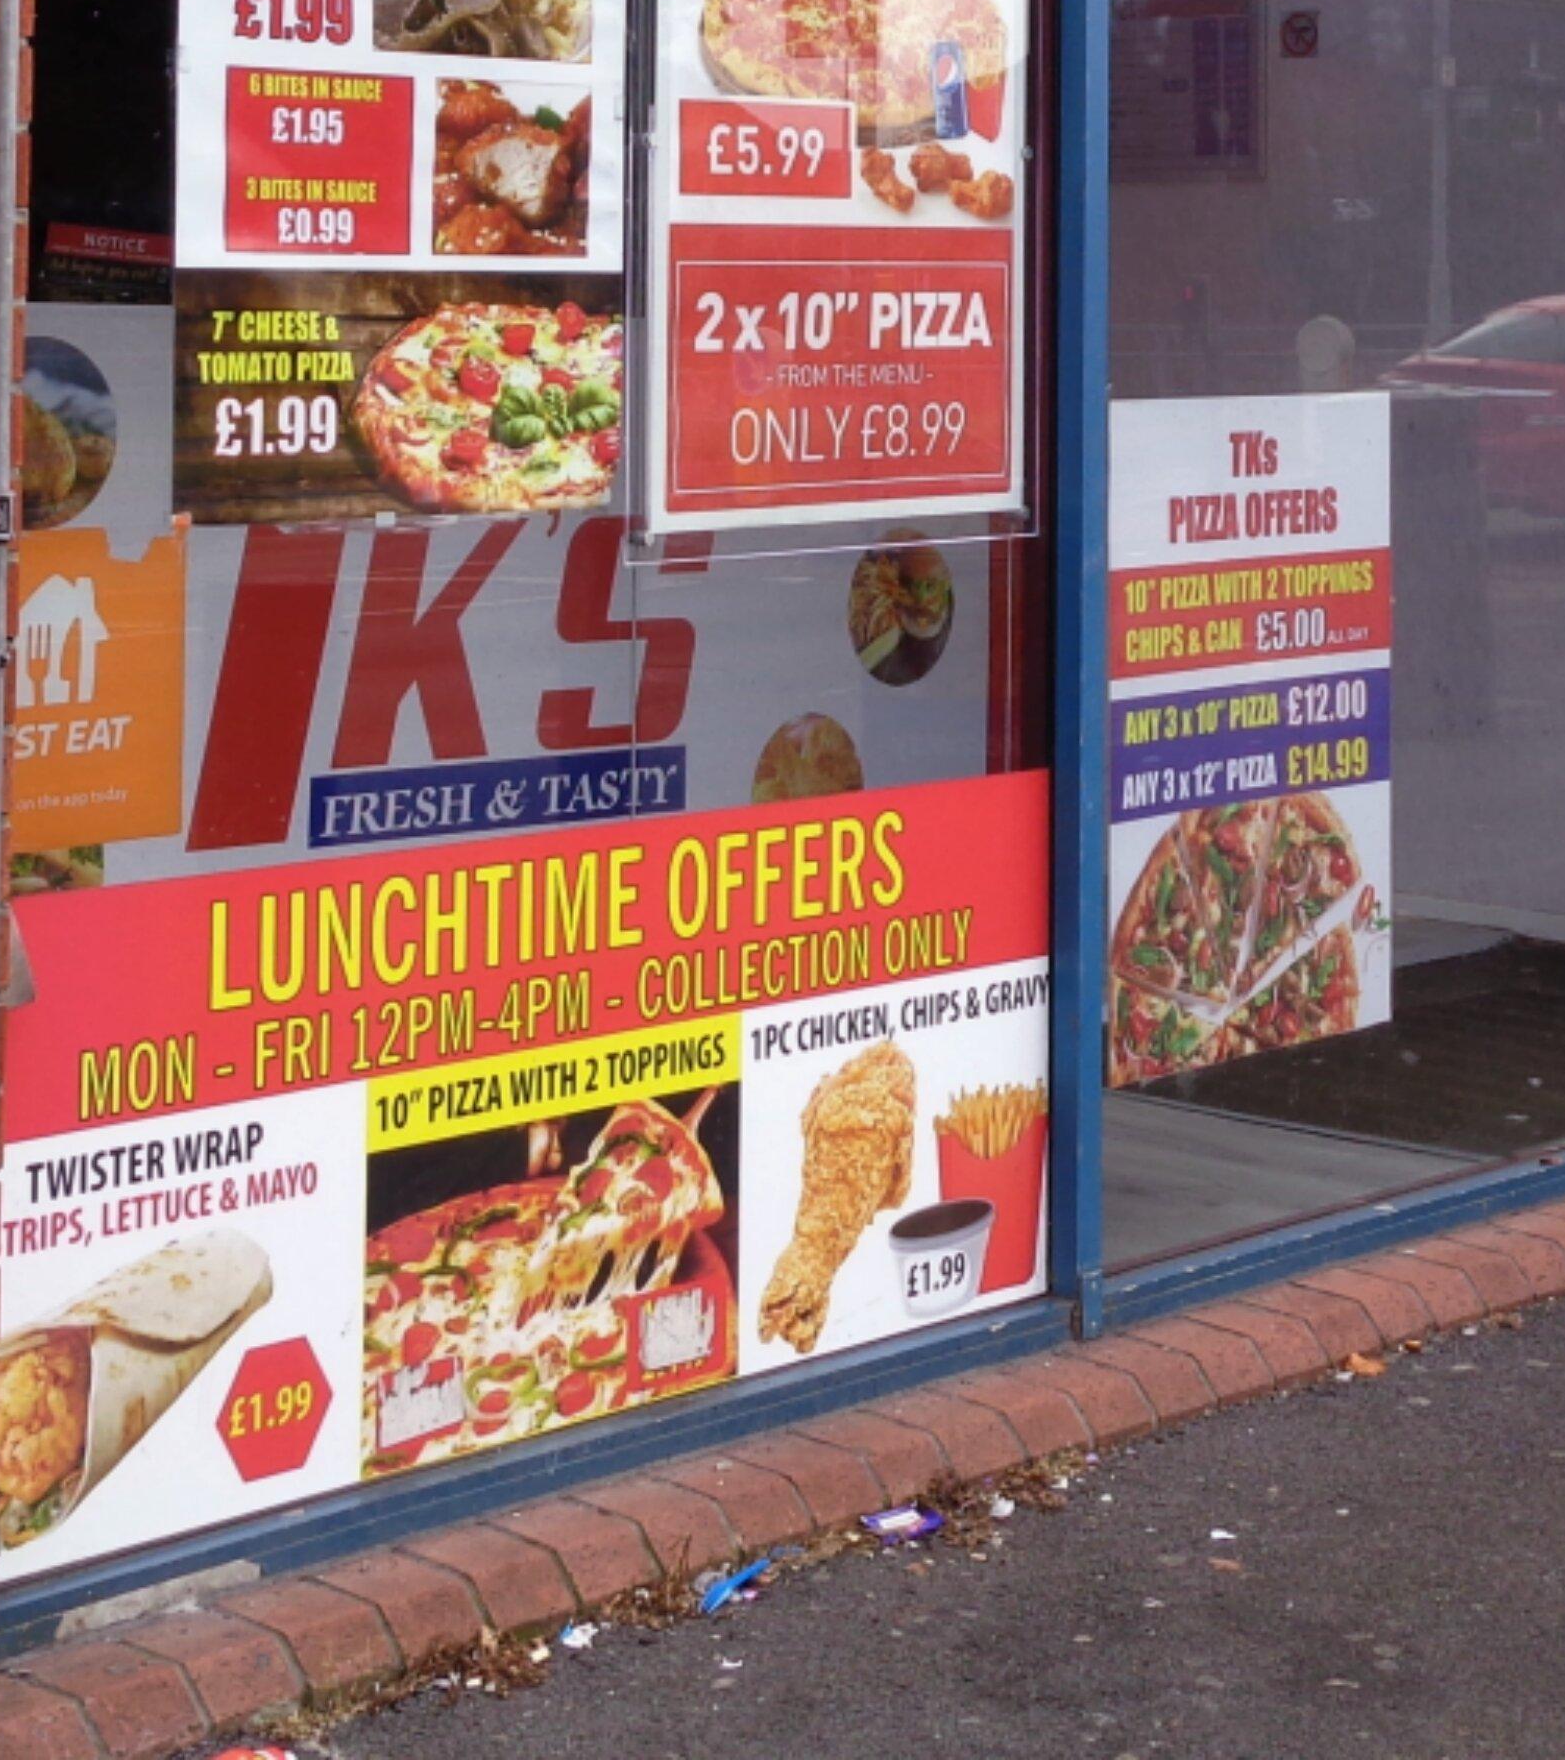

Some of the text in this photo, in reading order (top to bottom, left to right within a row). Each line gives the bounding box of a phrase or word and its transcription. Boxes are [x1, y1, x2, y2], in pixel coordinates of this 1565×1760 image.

[249, 73, 383, 103] 6 BITES IN SAUCE
[271, 106, 343, 145] £1.95
[707, 124, 824, 177] £5.99
[246, 176, 377, 204] 3 BITES IN SAUCE
[84, 233, 147, 253] NOTICE
[278, 207, 354, 244] £0.99
[239, 310, 339, 342] CHEESE &
[694, 292, 724, 353] 2
[733, 304, 766, 352] x
[870, 292, 993, 350] PIZZA
[197, 351, 355, 384] TOMATO PIZZA
[778, 363, 924, 387] FROM THE MENU
[214, 395, 337, 458] £1.99
[731, 401, 966, 466] ONLY £8.99
[1229, 430, 1279, 478] TKs
[1169, 486, 1339, 544] PIZZA OFFERS
[1160, 574, 1211, 611] PIZZA
[1213, 569, 1263, 606] WITH
[1266, 567, 1278, 600] 2
[1282, 560, 1374, 598] TOPPINGS
[1125, 607, 1326, 663] CHIPS & CAN £5.00
[65, 715, 134, 754] EAT
[1123, 707, 1162, 746] ANY
[1164, 705, 1178, 740] 3
[1181, 709, 1193, 737] x
[1228, 692, 1279, 731] PIZZA
[1287, 679, 1367, 727] £12.00
[37, 787, 128, 808] the app today
[1122, 769, 1160, 810] ANY
[1163, 766, 1175, 804] 3
[1179, 770, 1191, 801] x
[1226, 752, 1278, 792] PIZZA
[1288, 736, 1368, 786] £14.99
[320, 764, 679, 840] FRESH & TASTY
[208, 810, 904, 1011] LUNCHTIME OFFERS
[78, 906, 973, 1121] MON FRI 12PM-4PM COLLECTION ONLY
[751, 973, 1050, 1061] 1PC CHICKEN, CHIPS & GRAVY
[428, 1074, 502, 1123] PIZZA
[509, 1060, 577, 1105] WITH
[585, 1058, 599, 1092] 2
[606, 1032, 725, 1088] TOPPINGS
[25, 1122, 265, 1204] TWISTER WRAP
[101, 1180, 212, 1237] LETTUCE
[219, 1177, 240, 1213] &
[246, 1162, 318, 1208] MAYO
[907, 1252, 965, 1299] £1.99
[228, 1381, 313, 1439] £1.99
